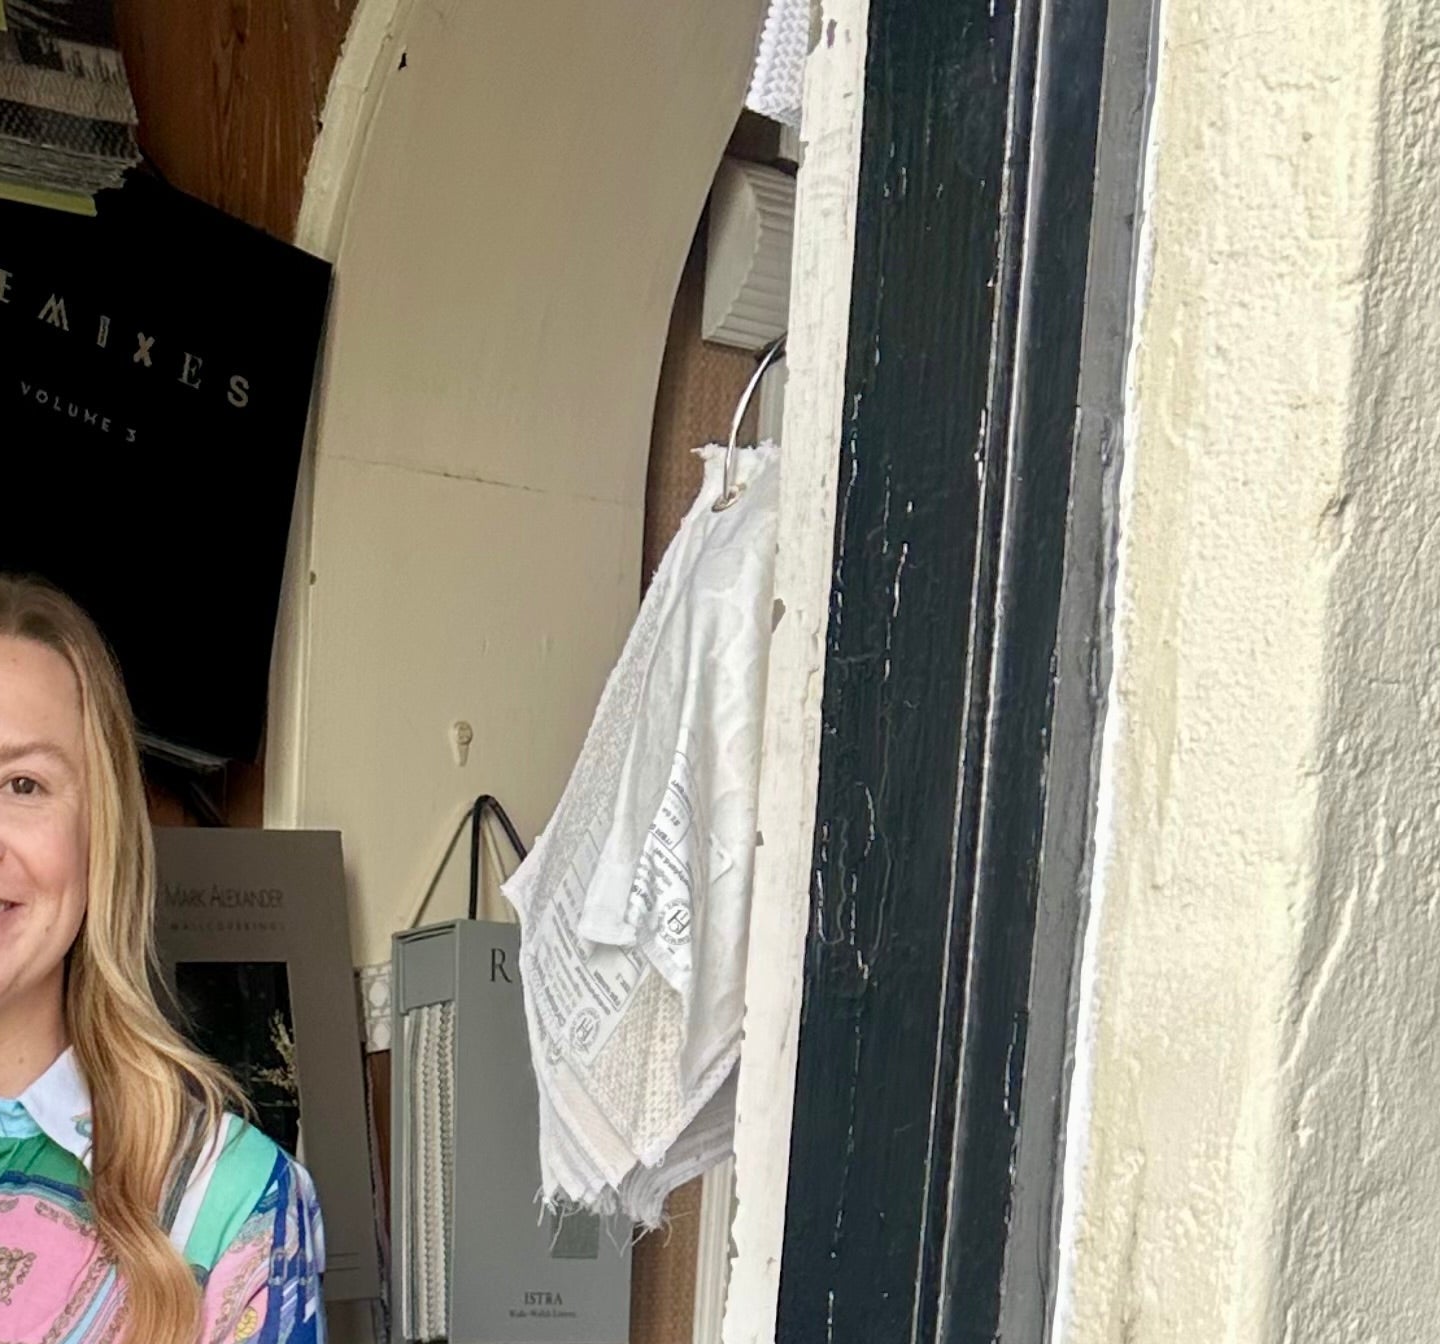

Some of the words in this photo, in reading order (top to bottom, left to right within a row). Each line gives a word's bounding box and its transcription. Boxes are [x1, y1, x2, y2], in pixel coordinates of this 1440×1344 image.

[21, 381, 111, 432] VOLUME
[125, 427, 137, 443] 3
[490, 947, 513, 983] R
[524, 1291, 563, 1306] ISTRA
